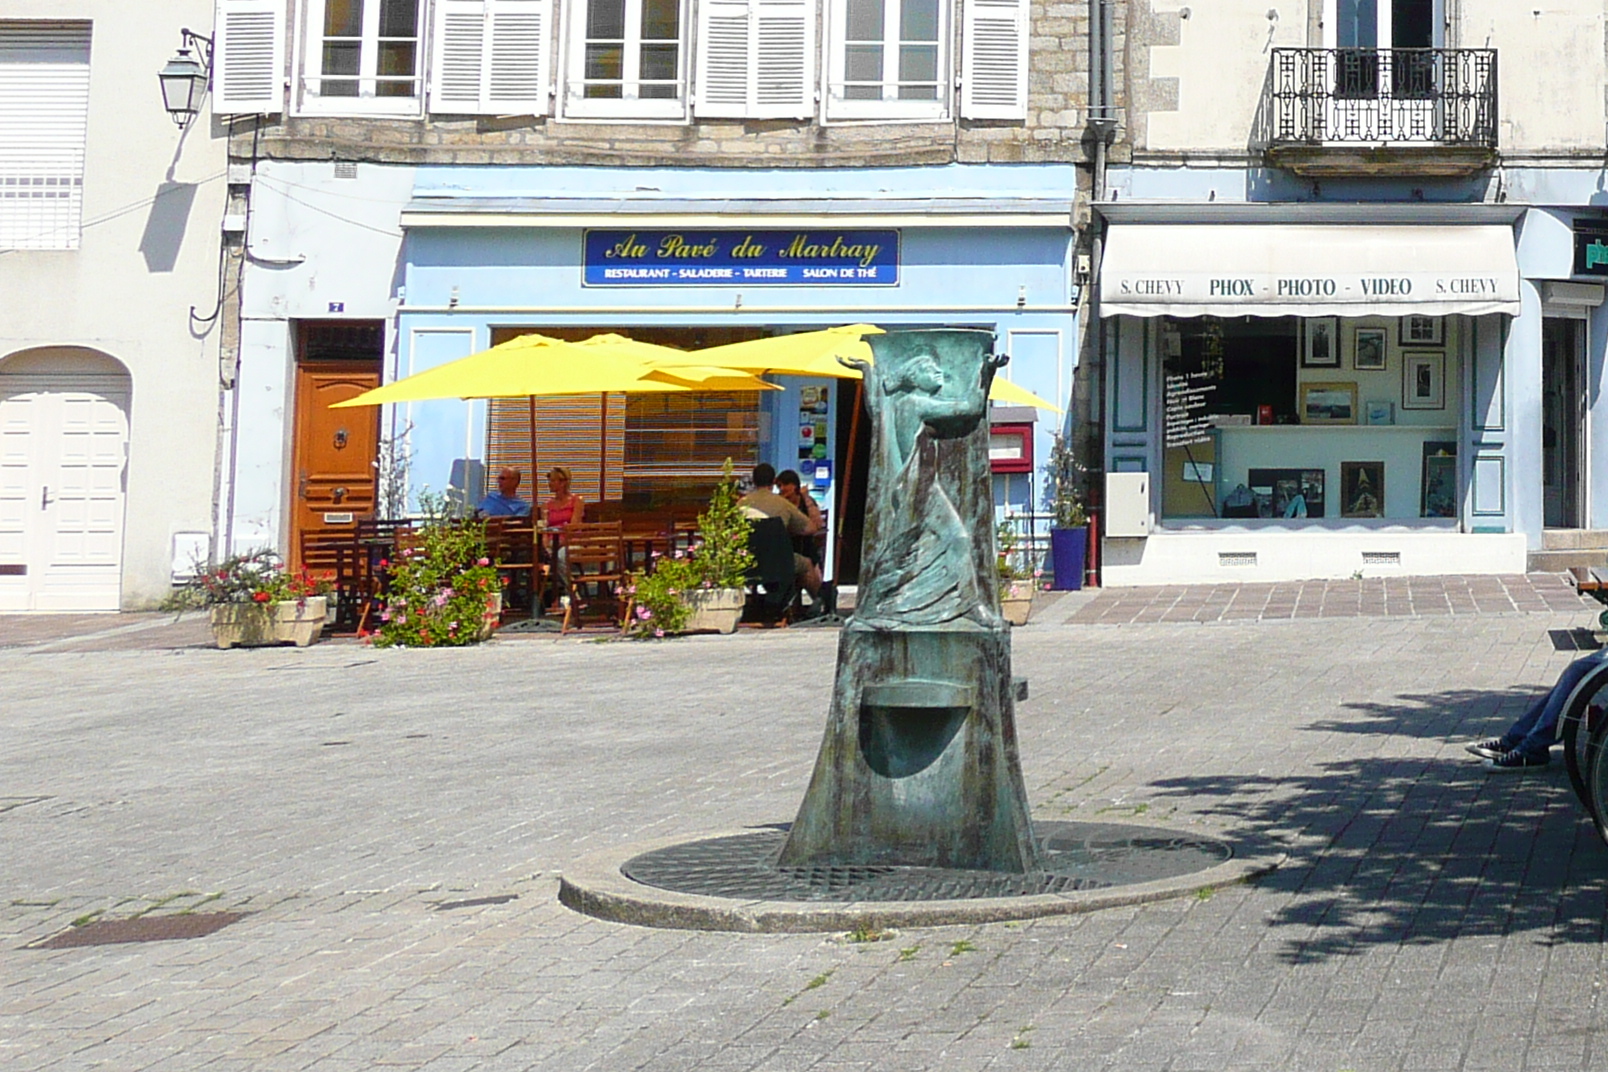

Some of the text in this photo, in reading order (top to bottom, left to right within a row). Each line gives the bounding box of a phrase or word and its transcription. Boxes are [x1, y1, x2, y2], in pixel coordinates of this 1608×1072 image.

[605, 234, 880, 267] Au Pavé du Martray
[604, 268, 670, 278] RESTAURANT
[679, 268, 733, 278] SALADERIE
[743, 268, 788, 278] TARTERIE
[803, 268, 837, 278] SALON
[840, 268, 855, 278] DE
[858, 266, 877, 278] THÉ
[1120, 280, 1132, 295] S.
[1135, 279, 1185, 295] CHEVY
[1210, 279, 1254, 296] PHOX
[1277, 279, 1336, 296] PHOTO
[1360, 278, 1412, 296] VIDEO
[1436, 279, 1447, 294] S.
[1450, 278, 1499, 294] CHEVY
